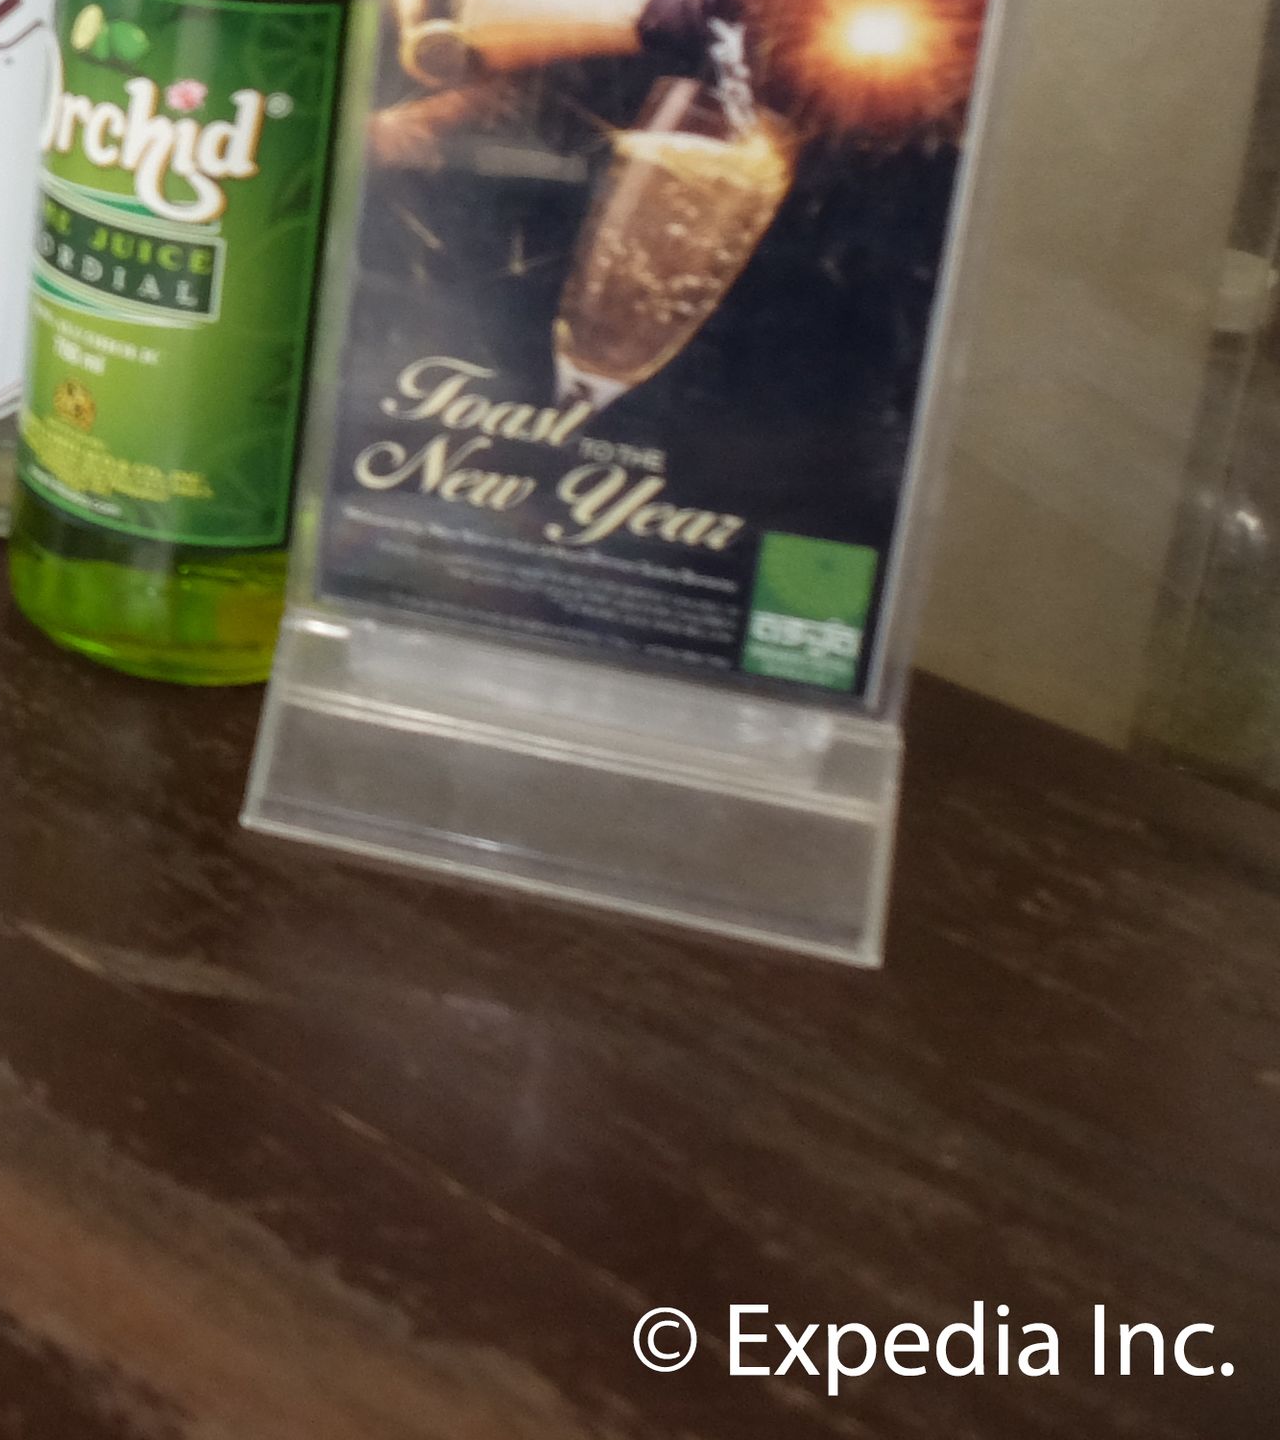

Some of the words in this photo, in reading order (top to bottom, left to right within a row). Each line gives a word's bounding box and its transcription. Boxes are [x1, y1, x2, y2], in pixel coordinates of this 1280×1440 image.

[90, 227, 213, 275] JUICE
[380, 356, 596, 447] Toast
[578, 437, 615, 462] TO
[622, 444, 667, 473] THE
[353, 435, 537, 511] New
[544, 462, 745, 551] Year
